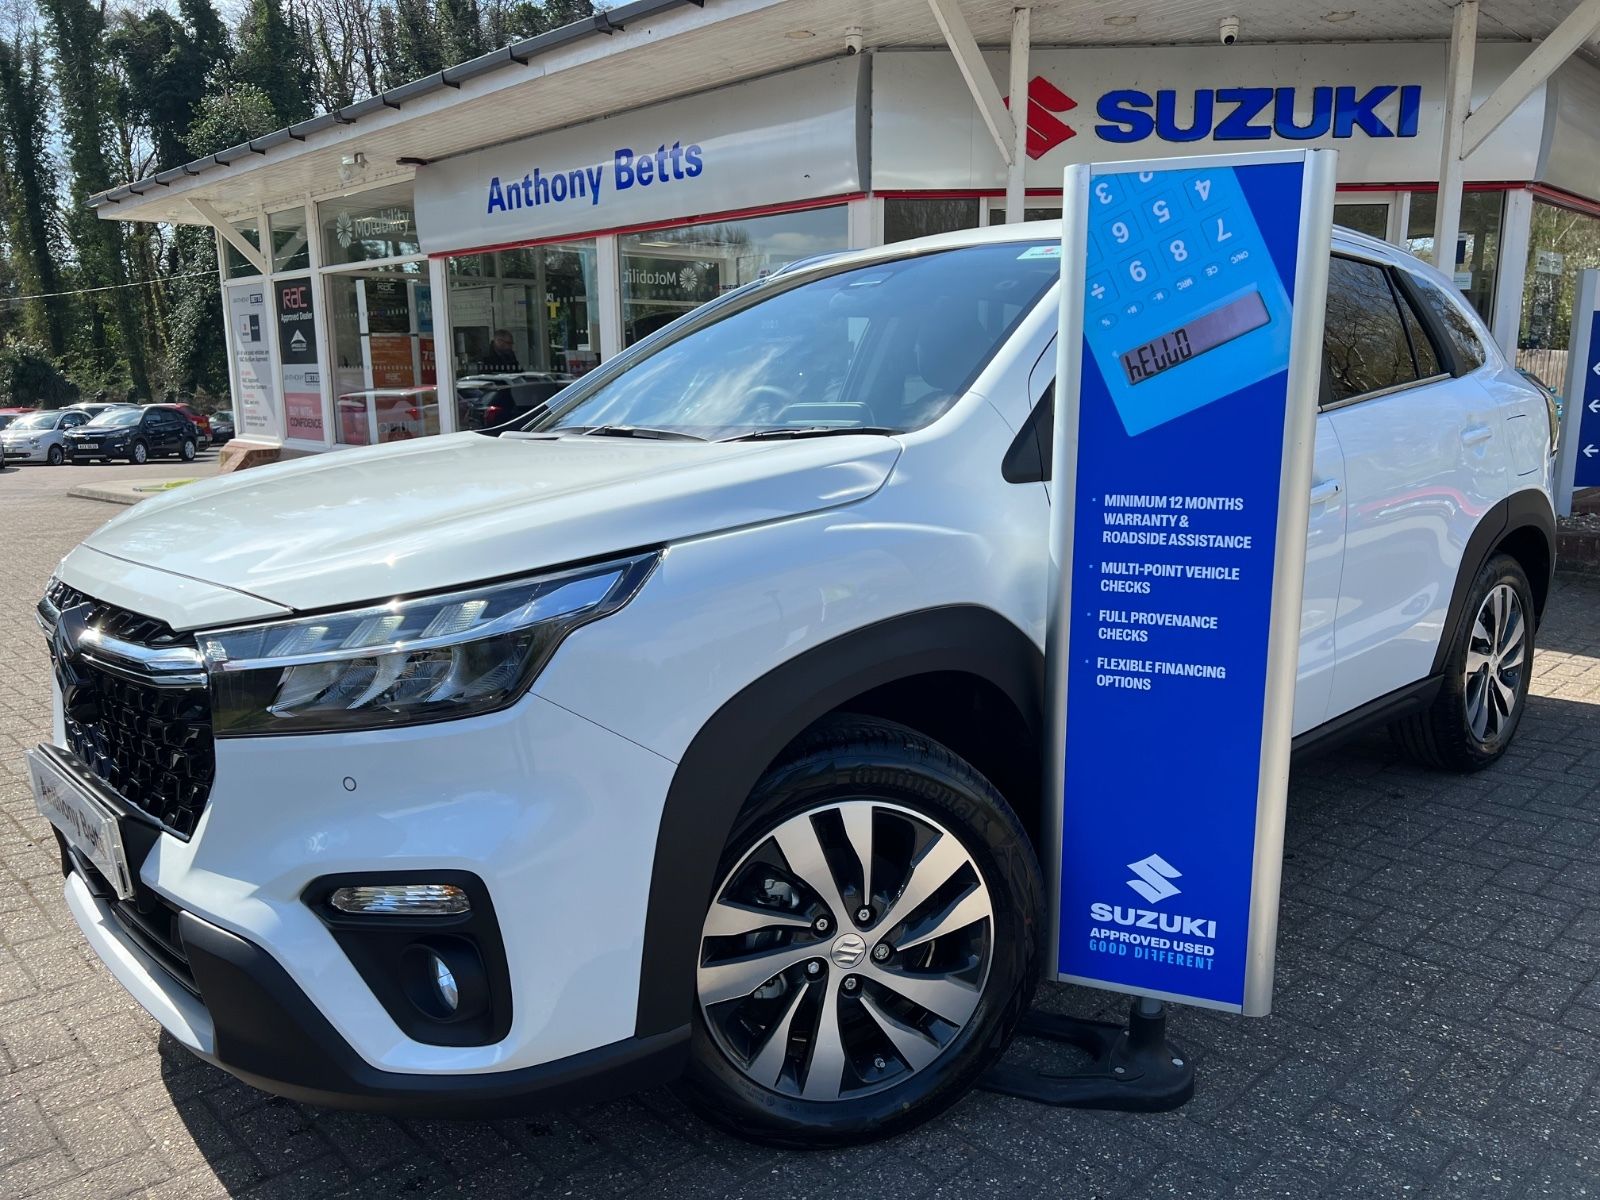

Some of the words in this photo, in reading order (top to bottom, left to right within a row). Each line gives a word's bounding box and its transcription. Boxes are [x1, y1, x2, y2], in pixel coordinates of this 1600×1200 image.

[1094, 85, 1421, 143] SUZUKI
[487, 168, 603, 214] Anthony
[615, 141, 703, 190] Betts
[354, 208, 409, 237] Motability
[1105, 494, 1167, 508] MINIMUM
[1169, 496, 1183, 509] 12
[1185, 496, 1244, 511] MONTHS
[1104, 513, 1178, 527] WARRANTY
[1179, 515, 1189, 528] &
[1103, 531, 1167, 545] ROADSIDE
[1168, 533, 1252, 549] ASSISTANCE
[1101, 561, 1183, 577] MULTI-POINT
[1185, 566, 1240, 580] VEHICLE
[1100, 579, 1151, 594] CHECKS
[1099, 610, 1128, 623] FULL
[1130, 612, 1218, 629] PROVENANCE
[1098, 627, 1148, 642] CHECKS
[1097, 657, 1153, 673] FLEXIBLE
[1154, 661, 1226, 679] FINANCING
[1096, 674, 1151, 690] OPTIONS
[1090, 902, 1217, 939] SUZUKI
[1089, 927, 1171, 949] APPROVED
[1173, 940, 1215, 956] USED
[1089, 939, 1127, 956] GOOD
